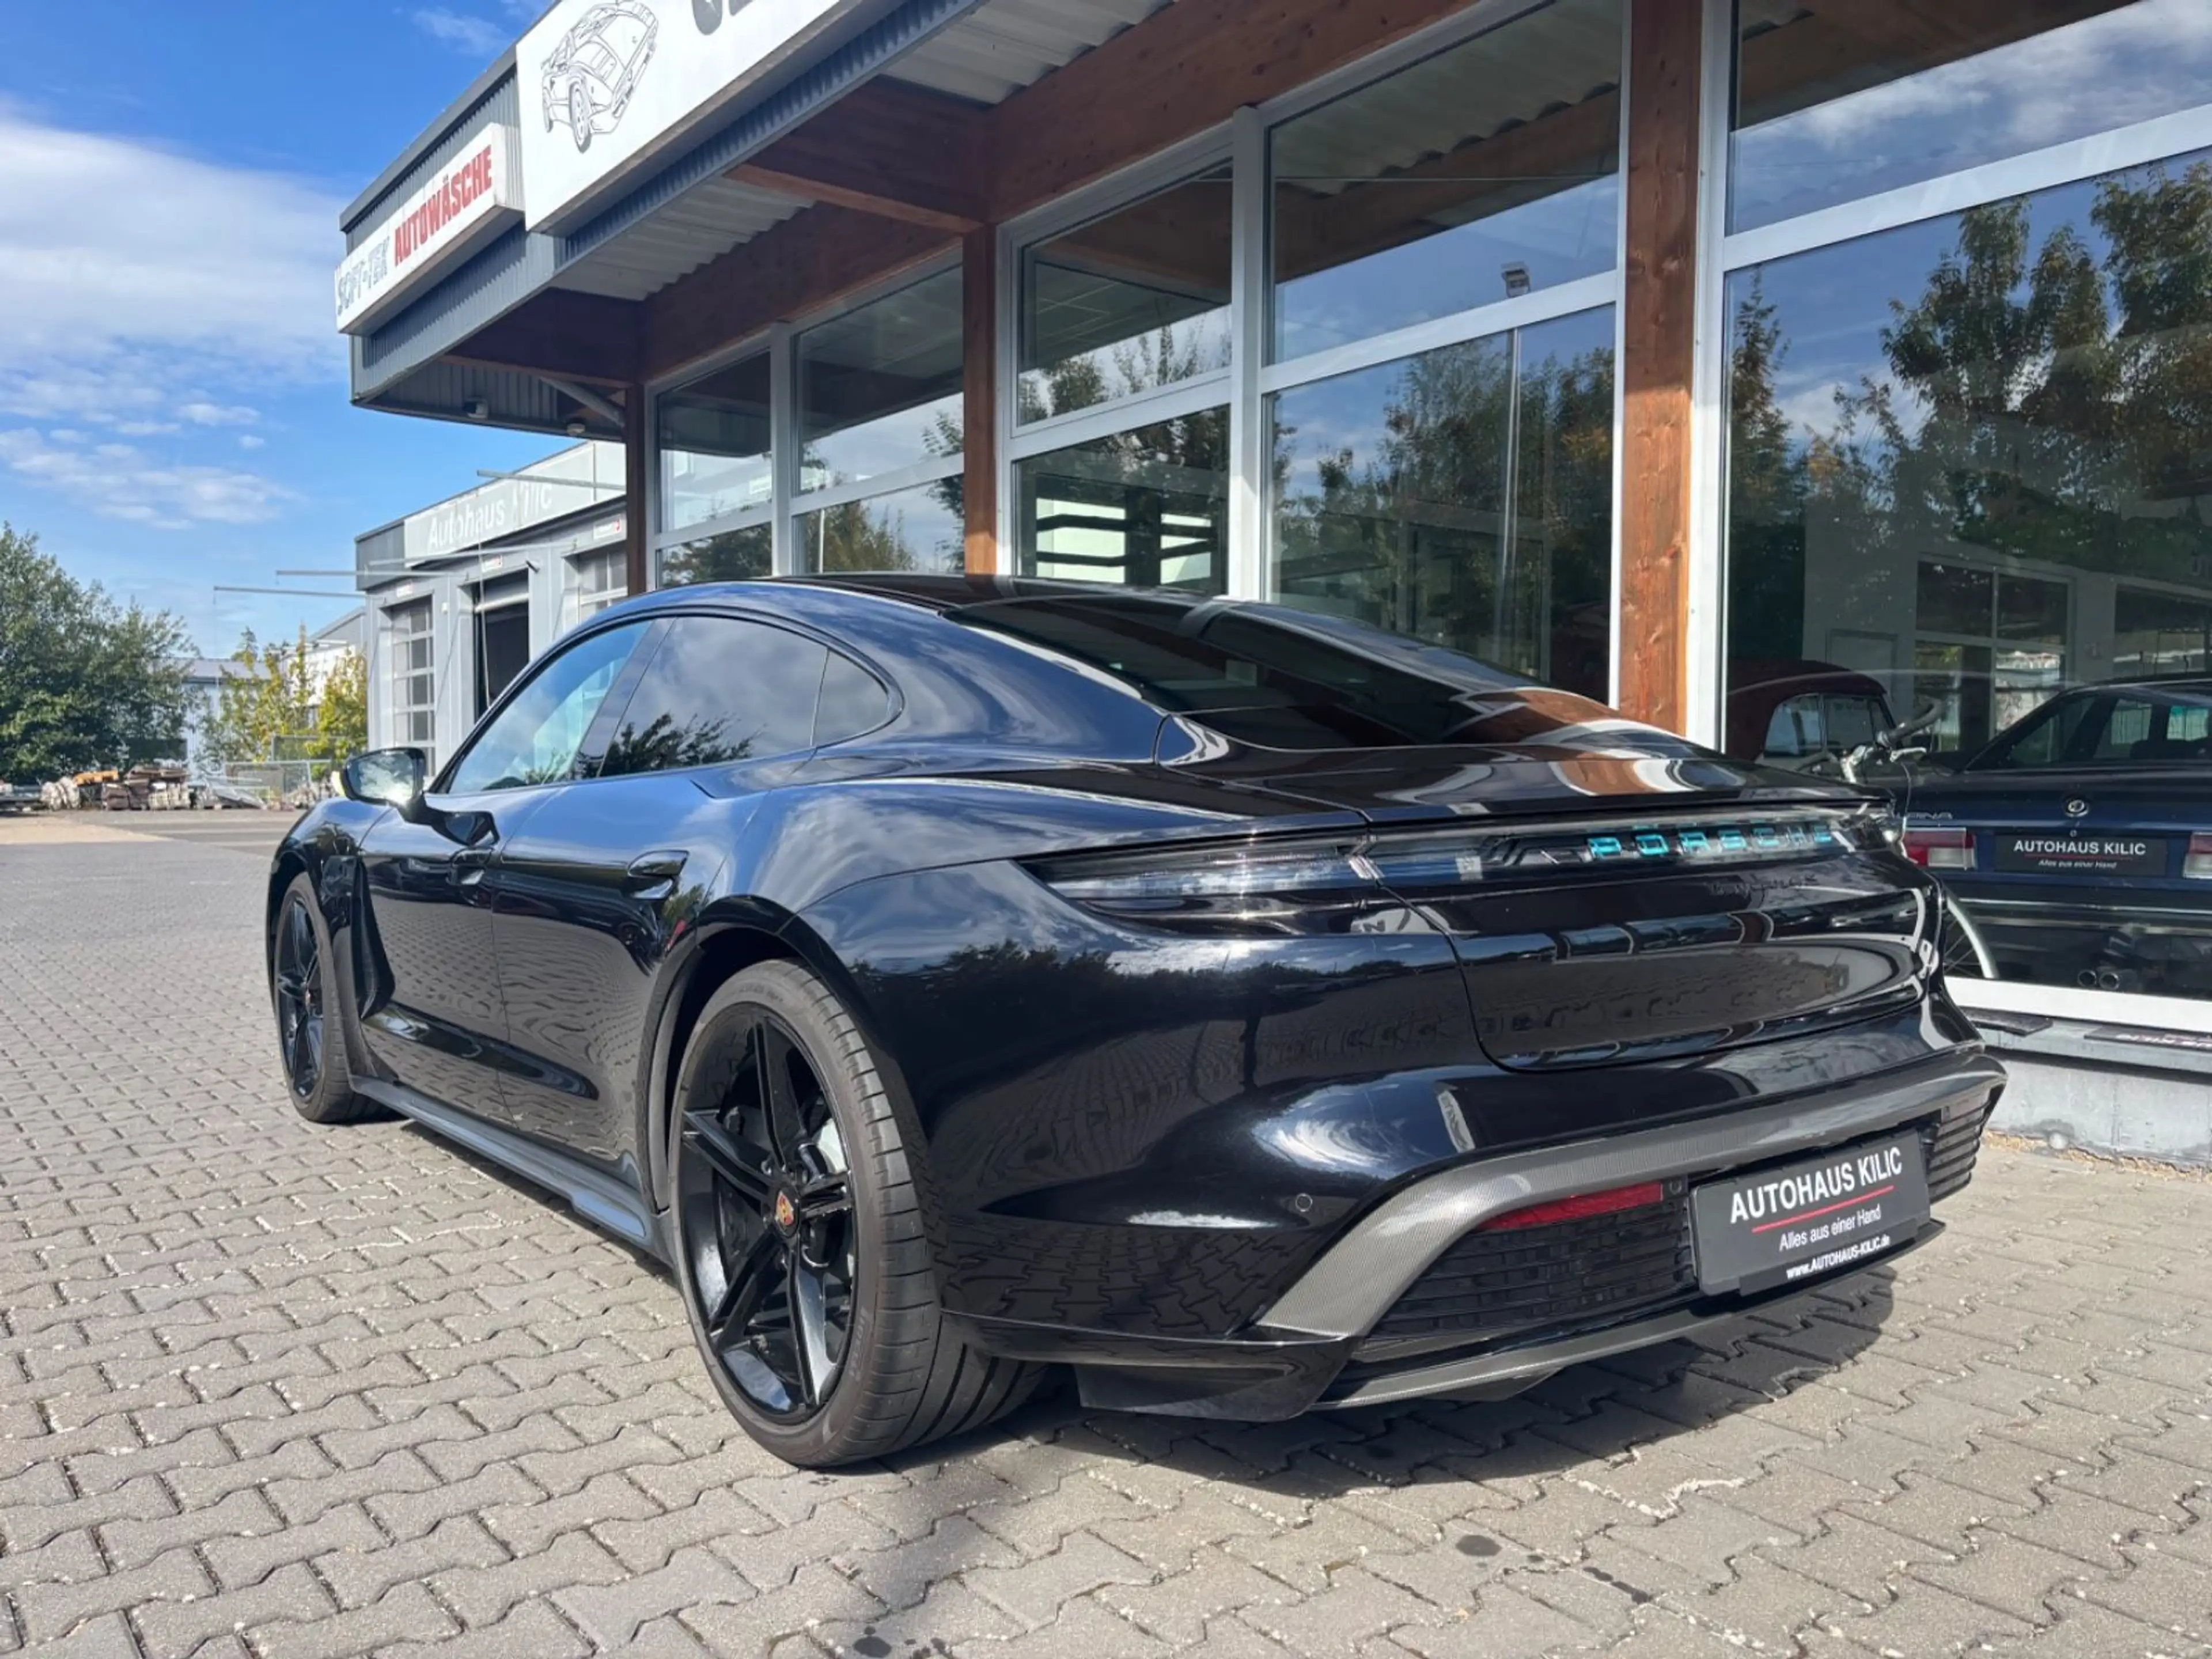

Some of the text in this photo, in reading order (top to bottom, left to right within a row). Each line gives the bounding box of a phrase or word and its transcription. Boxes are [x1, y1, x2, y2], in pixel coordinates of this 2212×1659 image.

[394, 144, 492, 267] AUTOWÄSCHE
[427, 498, 505, 547] Autohaus
[1588, 824, 1832, 859] PORSCHE
[2013, 840, 2146, 855] AUTOHAUS KILIC
[1730, 1146, 1903, 1224] AUTOHAUS KILIC
[1779, 1203, 1881, 1252] Alles aus einer Hand
